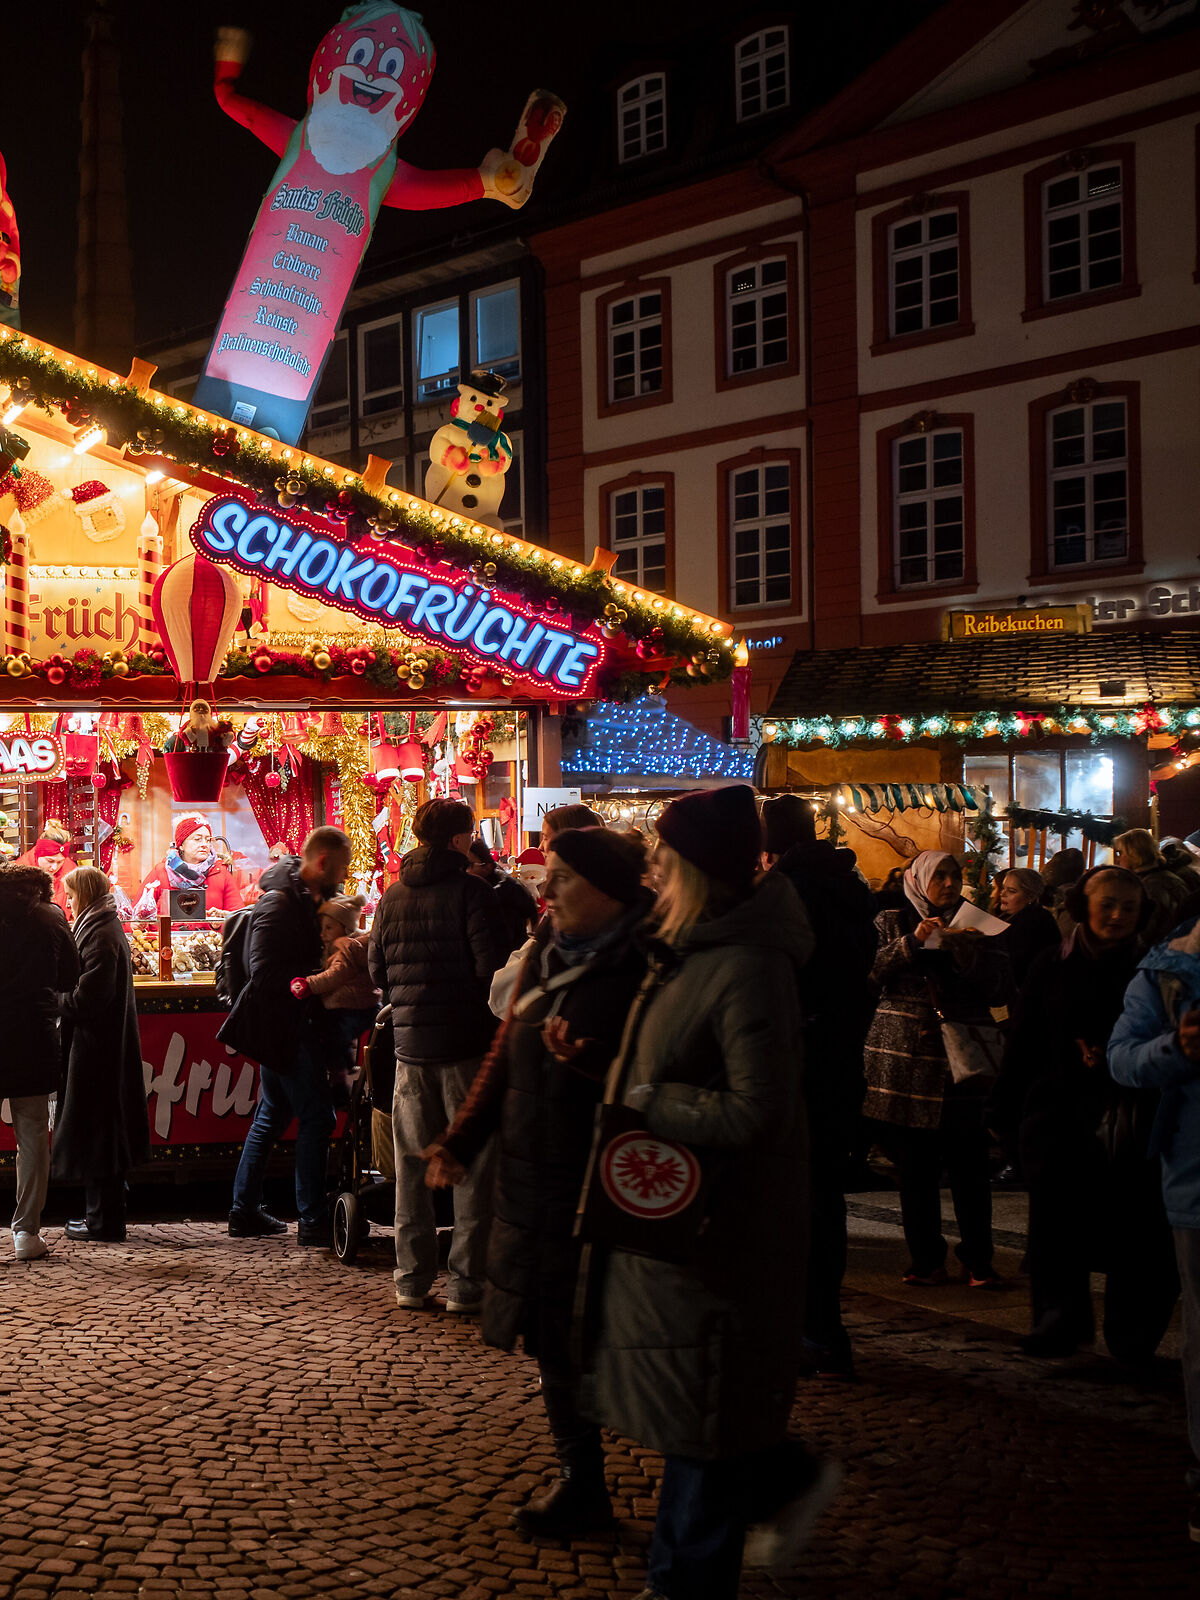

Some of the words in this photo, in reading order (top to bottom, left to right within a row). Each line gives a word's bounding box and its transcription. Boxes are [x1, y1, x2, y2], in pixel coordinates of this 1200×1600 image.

[270, 183, 323, 212] Santas
[315, 190, 365, 237] Früchte
[285, 222, 329, 254] Banane
[272, 250, 321, 281] Erdbeere
[249, 277, 322, 315] Schokofrüchte
[253, 305, 298, 335] Reinste
[218, 333, 311, 378] Pralinenschokolade
[204, 503, 598, 686] SCHOKOFRÜCHTE
[963, 614, 1064, 636] Reibekuchen
